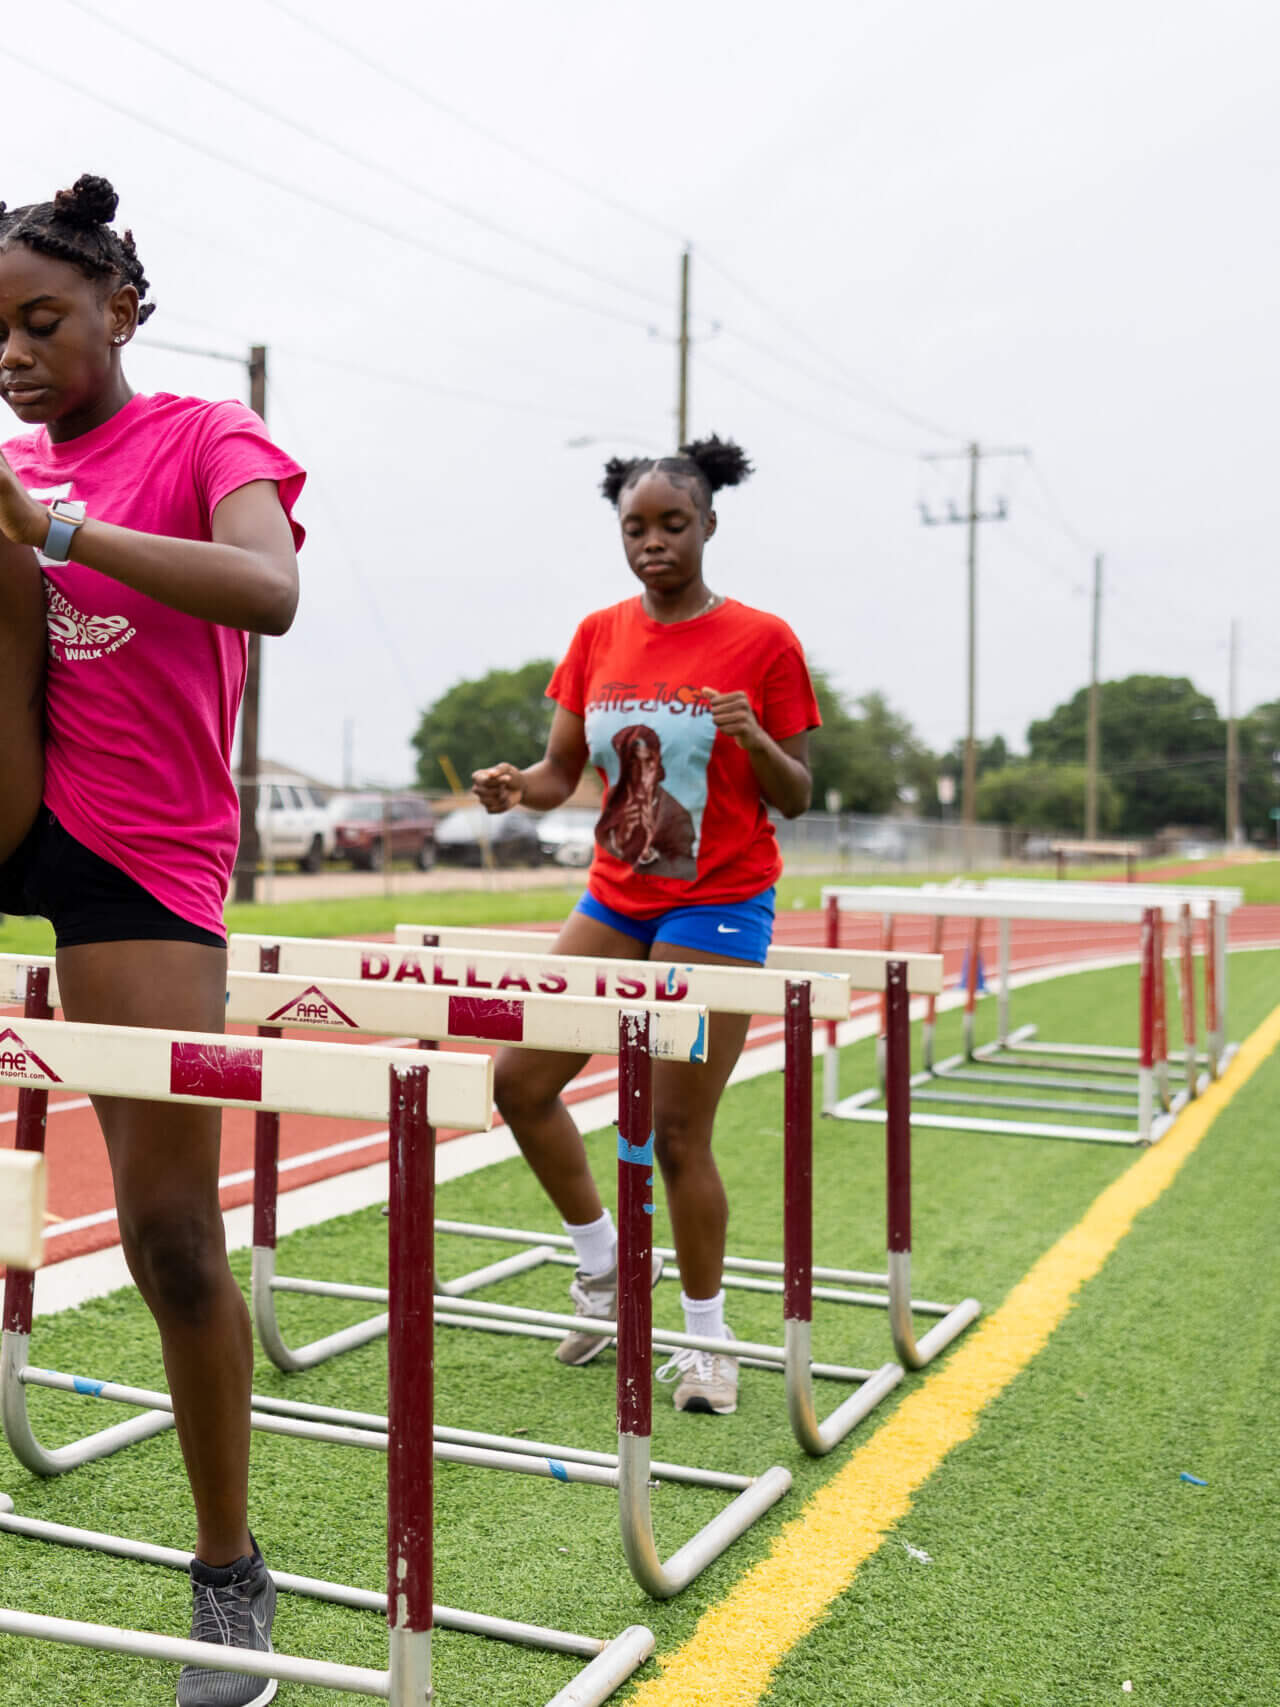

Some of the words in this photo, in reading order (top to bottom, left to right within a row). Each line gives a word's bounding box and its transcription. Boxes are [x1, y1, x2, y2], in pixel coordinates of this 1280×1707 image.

[64, 647, 103, 661] WALK
[360, 951, 569, 995] DALLAS
[594, 965, 690, 1002] ISD
